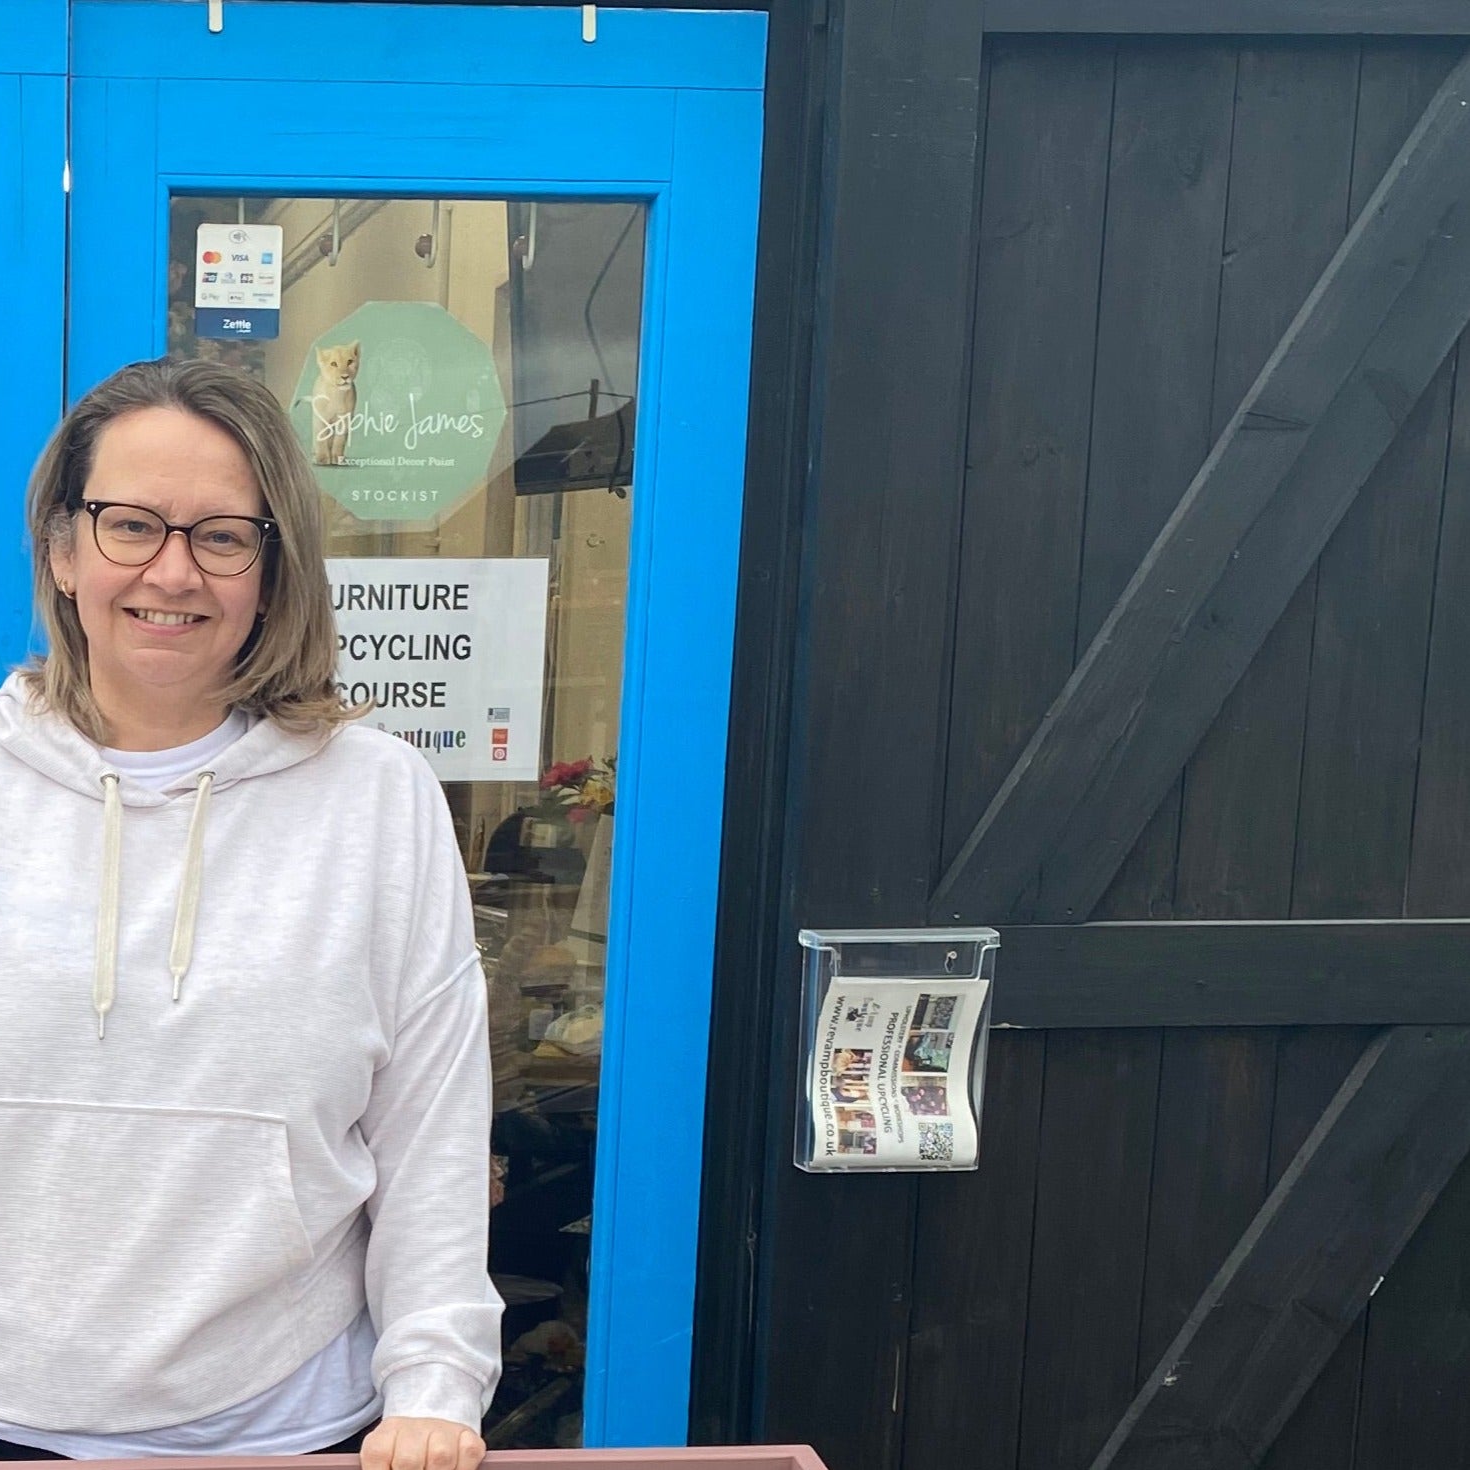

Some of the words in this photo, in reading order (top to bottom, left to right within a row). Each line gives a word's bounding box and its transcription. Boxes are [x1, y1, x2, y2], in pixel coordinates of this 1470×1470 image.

[222, 318, 252, 329] Zettle
[296, 394, 399, 448] Sophie
[404, 392, 484, 450] James
[337, 455, 395, 468] Exceptional
[428, 456, 455, 467] Paint
[351, 490, 439, 501] STOCKIST
[330, 584, 470, 611] URNITURE
[337, 634, 472, 661] PCYCLING
[876, 1012, 900, 1081] PROFESSIONAL
[818, 995, 846, 1157] www.revampboutique.co.uk
[890, 1050, 901, 1098] COMMISSIONS
[876, 1083, 893, 1133] UPCYCLING
